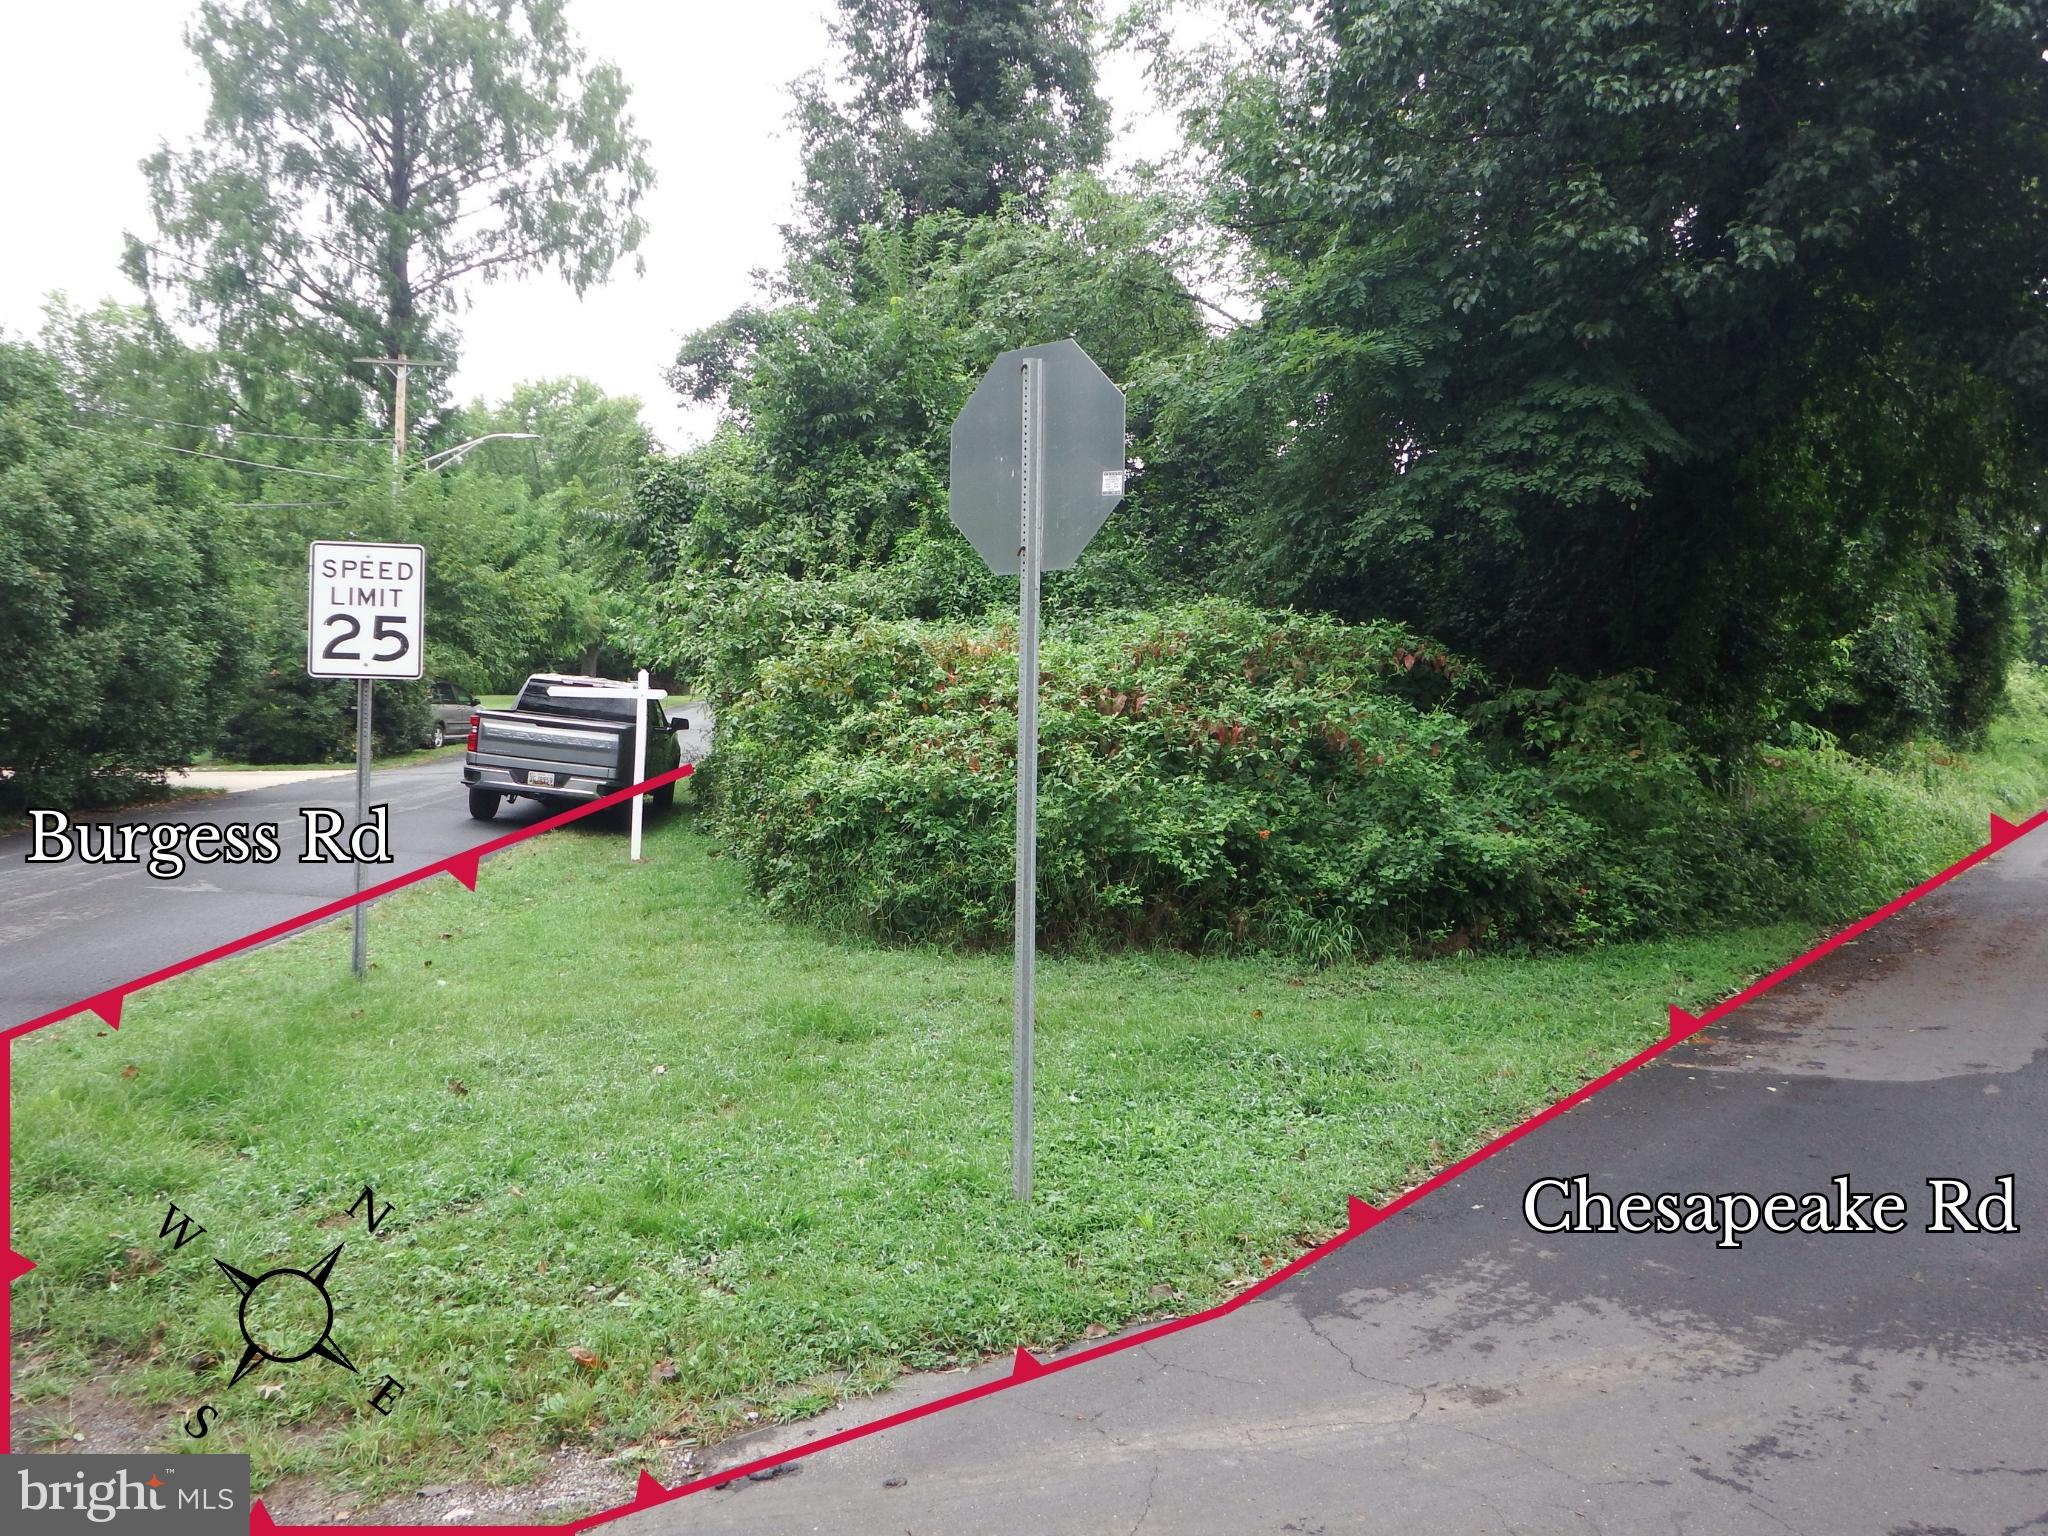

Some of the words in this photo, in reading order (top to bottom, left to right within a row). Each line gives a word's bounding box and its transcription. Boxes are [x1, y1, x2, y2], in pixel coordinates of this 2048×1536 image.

[322, 559, 413, 581] SPEED
[331, 587, 403, 607] LIMIT
[322, 613, 410, 662] 25
